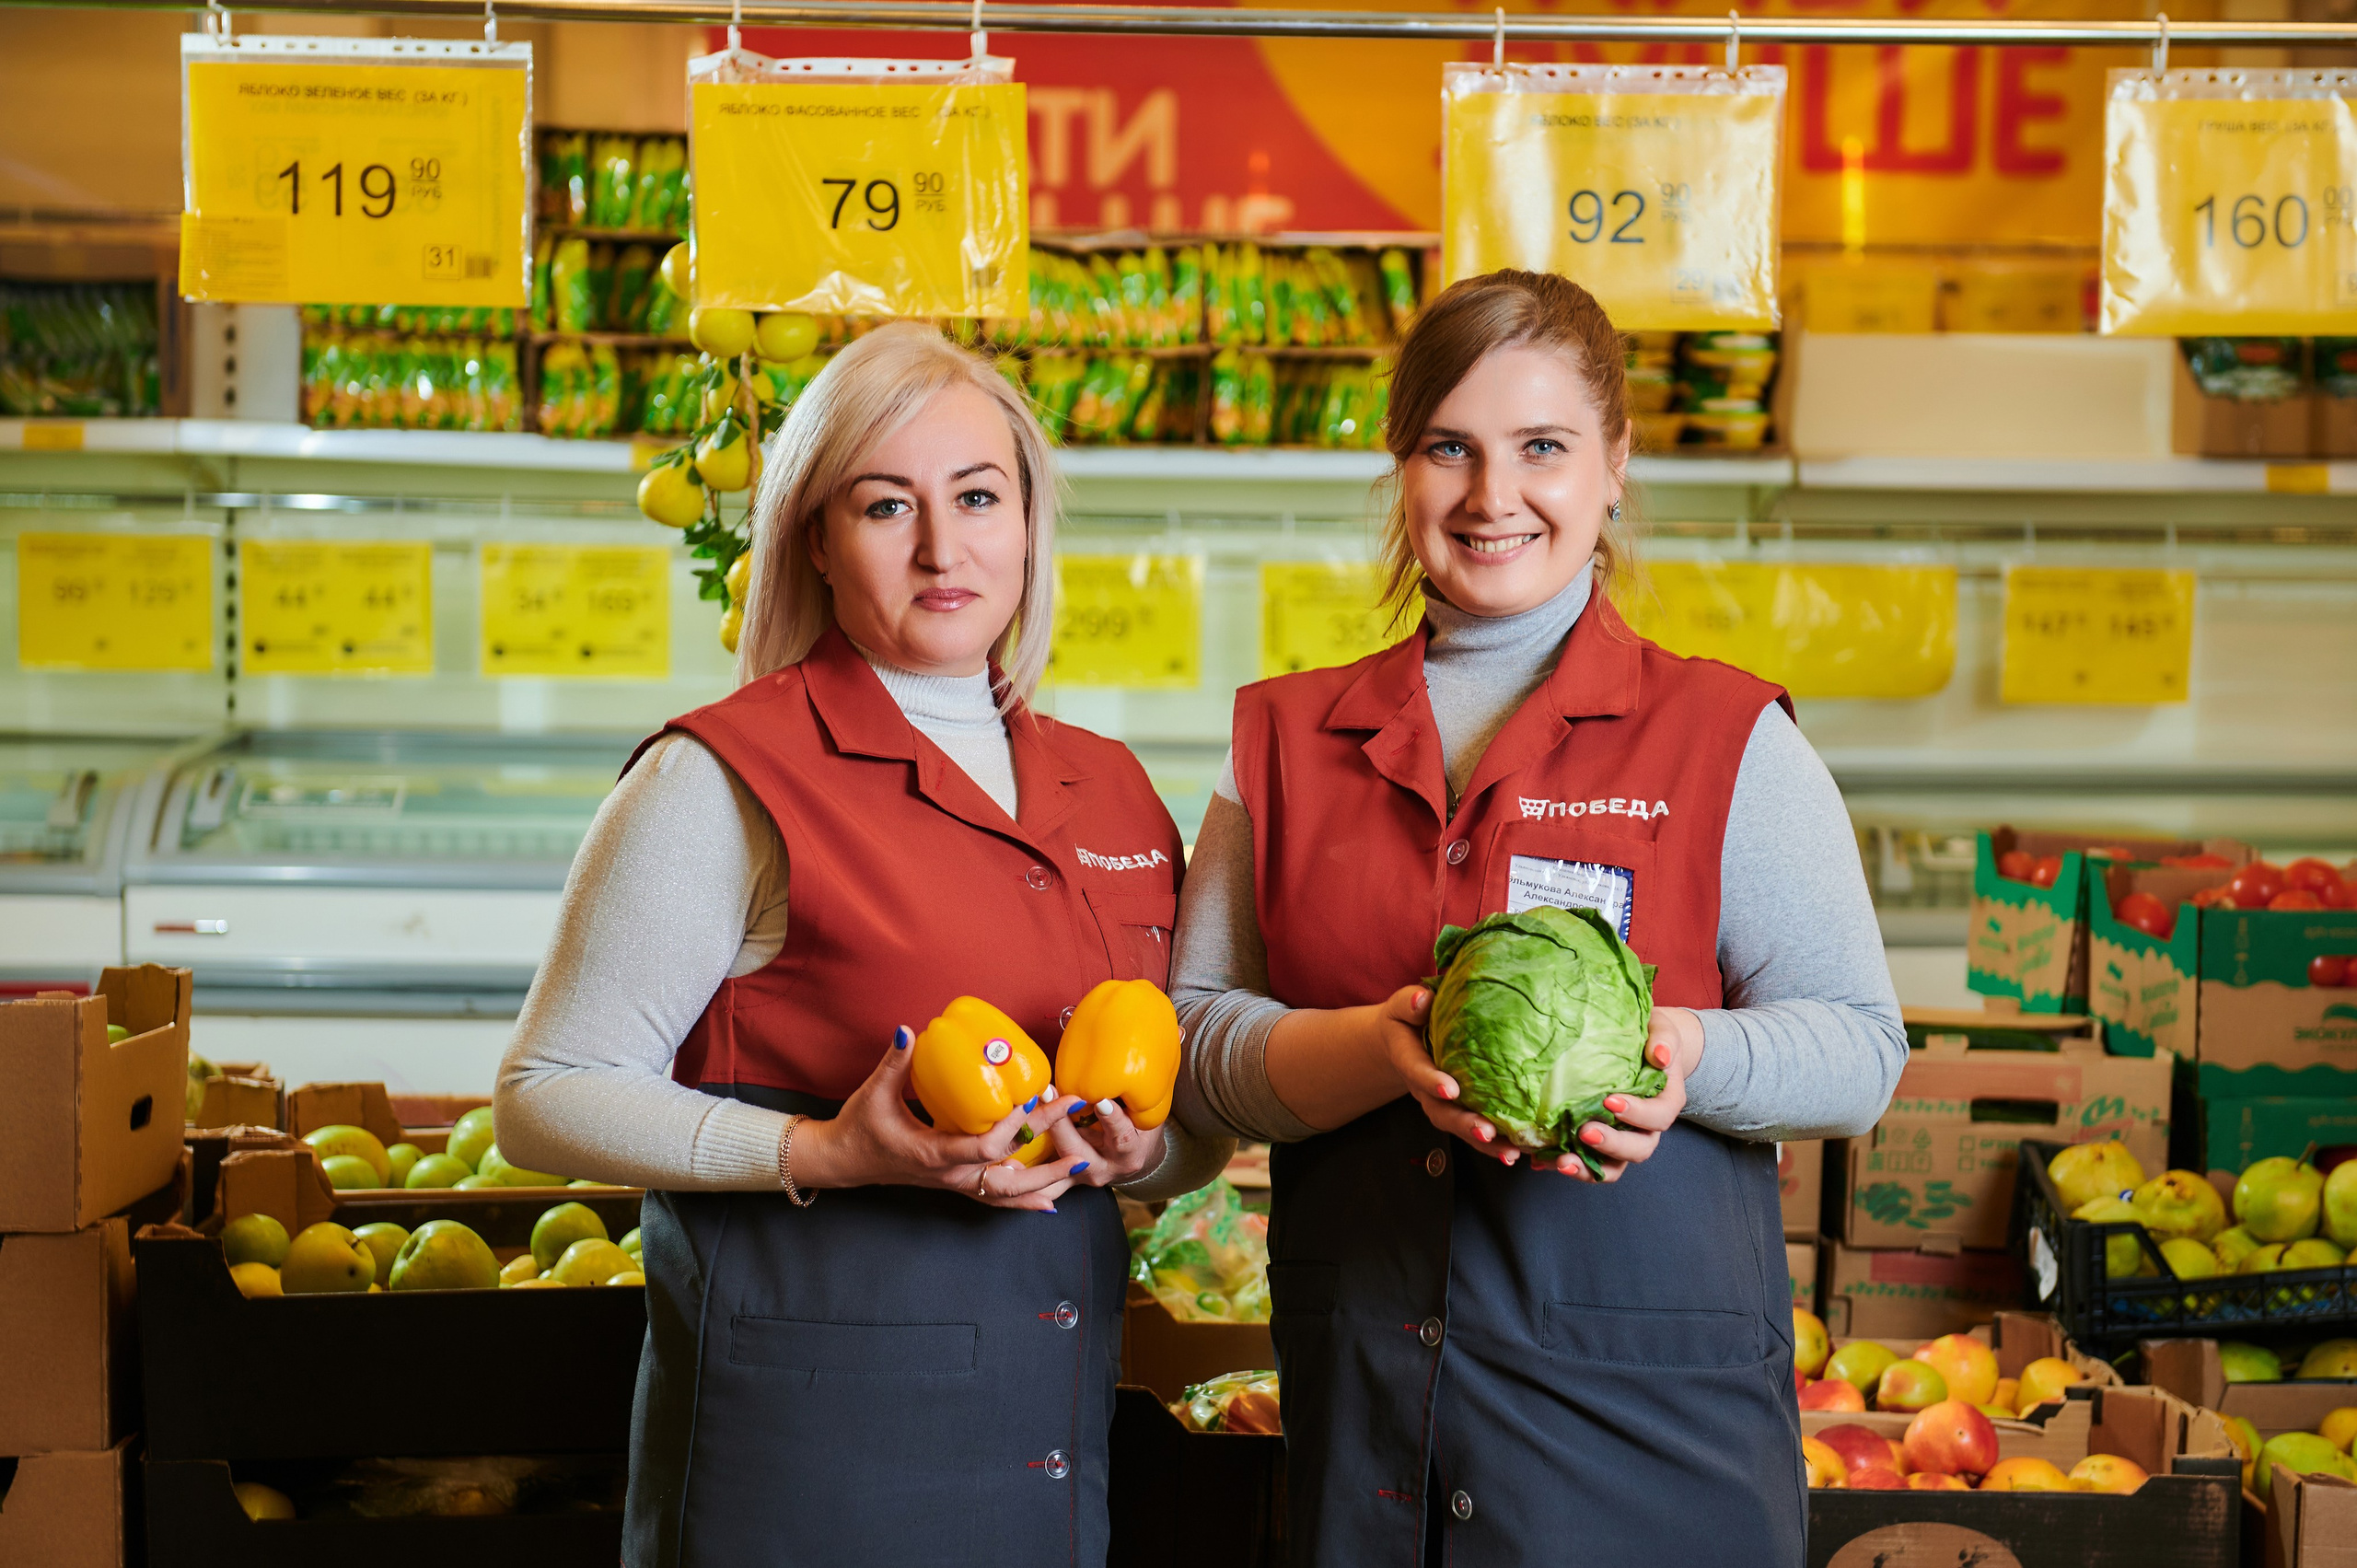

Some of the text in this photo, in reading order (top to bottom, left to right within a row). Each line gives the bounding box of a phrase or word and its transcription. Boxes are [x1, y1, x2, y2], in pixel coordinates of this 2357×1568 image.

[238, 83, 300, 96] ЯБЛОКО
[305, 85, 372, 99] ЗЕЛЕНОЕ
[377, 87, 406, 101] ВЕС
[719, 103, 780, 115] ЯБЛОКО
[786, 105, 886, 118] ФАСОВАННОЕ
[891, 106, 921, 118] ВЕС
[1594, 115, 1622, 126] ВЕС
[279, 160, 397, 218] 119
[410, 157, 442, 180] 90
[822, 172, 945, 231] 79 90
[1569, 183, 1692, 244] 92 90
[2194, 185, 2354, 248] 160 00
[428, 246, 455, 268] 31
[1548, 797, 1670, 820] ПОБЕДА
[1087, 849, 1169, 871] ПОБЕДА
[1563, 888, 1625, 909] Алексанра
